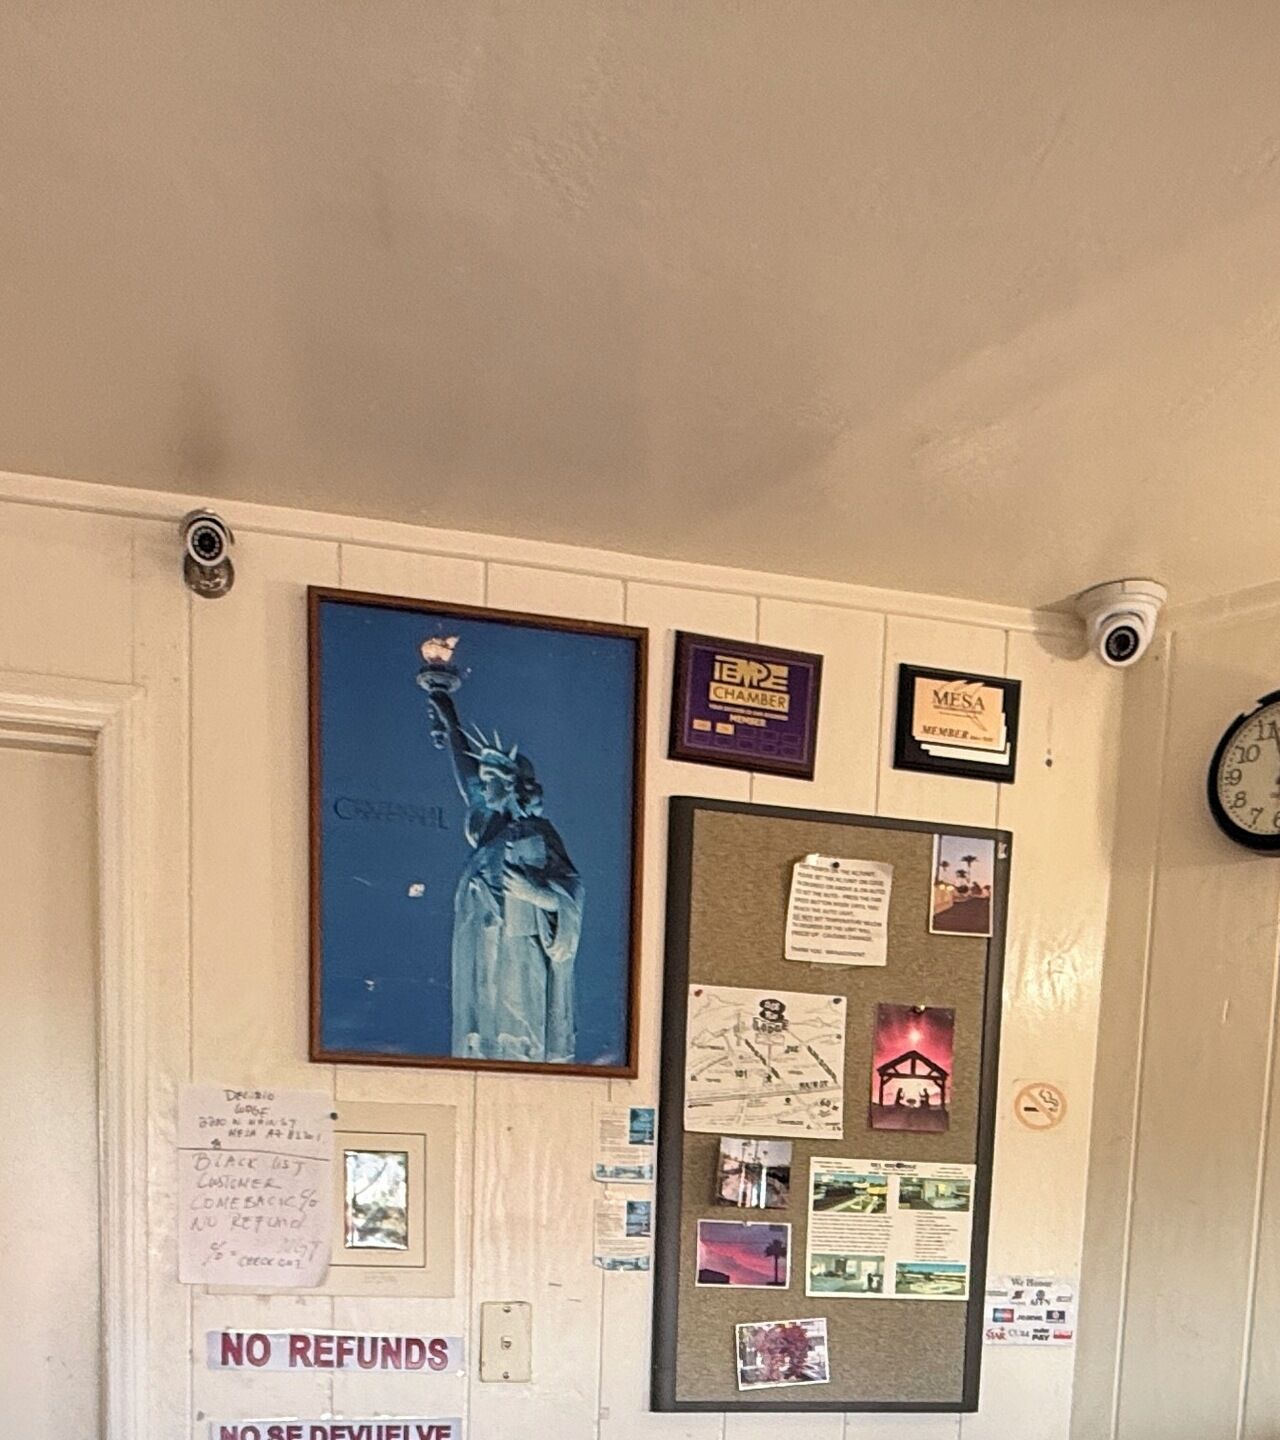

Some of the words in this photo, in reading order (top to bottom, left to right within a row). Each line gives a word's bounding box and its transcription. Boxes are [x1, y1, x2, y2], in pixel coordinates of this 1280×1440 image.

[713, 686, 786, 709] CHAMBER
[932, 689, 985, 711] MESA
[921, 724, 970, 739] MEMBER
[1234, 744, 1261, 764] 10
[1224, 768, 1243, 786] 9
[1232, 790, 1247, 809] 8
[1250, 807, 1264, 825] 7
[1025, 1278, 1053, 1288] Honor
[220, 1332, 271, 1368] NO
[288, 1333, 449, 1372] REFUNDS
